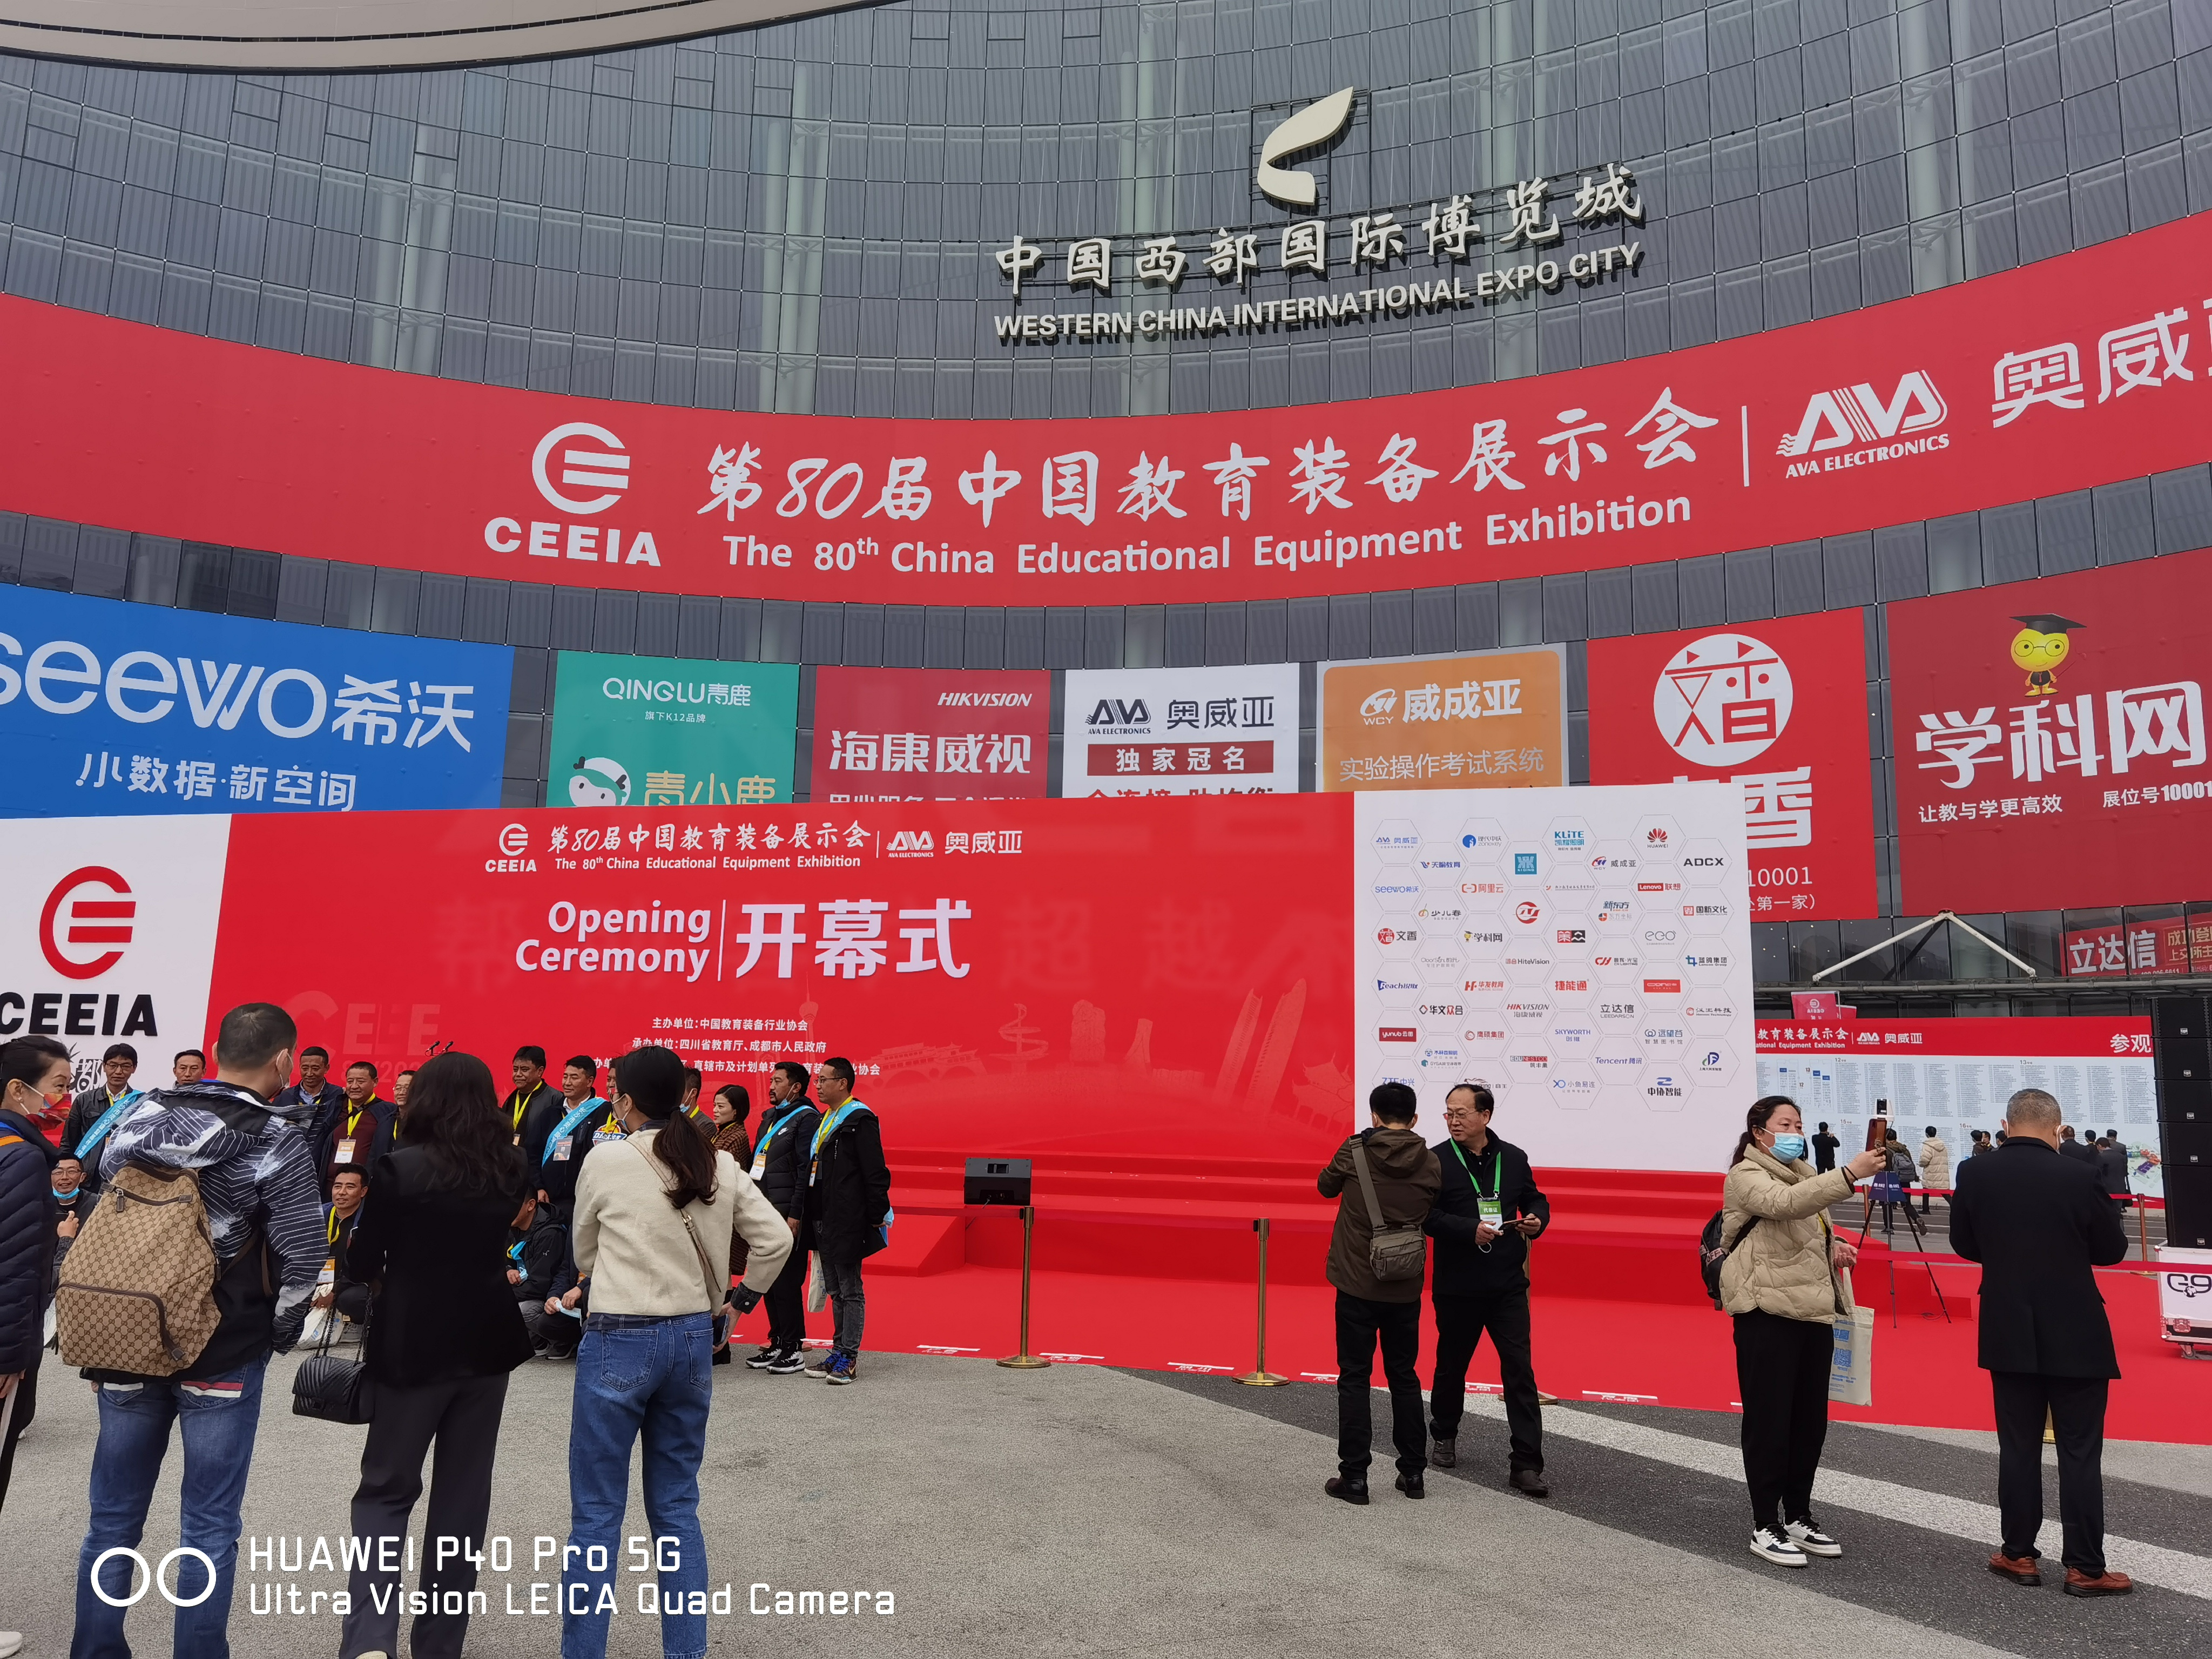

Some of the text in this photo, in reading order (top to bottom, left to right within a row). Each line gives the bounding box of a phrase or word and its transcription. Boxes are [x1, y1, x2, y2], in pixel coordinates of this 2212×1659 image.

[995, 163, 1643, 296] 中国西部国际博览城
[995, 241, 1641, 339] WESTERN CHINA INTERNATIONAL EXPO CITY
[1992, 298, 2212, 428] 奥威
[697, 387, 1718, 528] 第80届中国教育装备展示会
[1785, 434, 1949, 478] AVA ELECTRONICS
[484, 517, 661, 567] CEEIA
[723, 495, 1691, 574] The 80th China Educational Equipment Exhibition
[603, 677, 705, 705] QINGLU
[707, 683, 751, 707] 青鹿
[938, 692, 1033, 707] HIKVISION
[1402, 678, 1522, 723] 威成亚
[332, 674, 474, 752] 希沃
[645, 710, 706, 724] 旗下K12品牌
[1167, 696, 1274, 730] 奥威亚
[1363, 716, 1394, 725] WCY
[1916, 681, 2208, 790] 学科网
[830, 730, 1031, 773] 海康威视
[1116, 746, 1245, 773] 独家冠名
[1340, 747, 1544, 782] 实验操作考试系统
[2102, 780, 2212, 809] 展位号10001
[1918, 794, 2063, 825] 让教与学更高效
[548, 819, 871, 854] 第80届中国教育装备展示会
[945, 830, 1022, 854] 奥威亚
[485, 860, 537, 872] CEEIA
[556, 854, 860, 871] The 80th China Educational Equipment Exhibition
[1683, 858, 1725, 866] ADCX
[1478, 884, 1504, 893] 阿里云
[1603, 901, 1630, 911] 新东方
[548, 900, 711, 944] Opening
[1396, 930, 1417, 941] 文香
[735, 898, 972, 979] 开幕式
[1473, 933, 1503, 942] 学科网
[2168, 926, 2212, 947] 成功登
[516, 940, 710, 982] Ceremony
[2069, 930, 2156, 974] 立达信
[1555, 980, 1587, 991] 捷能通
[0, 992, 158, 1036] CEEIA
[1429, 1005, 1463, 1015] 华文众合
[1600, 1004, 1634, 1013] 立达信
[652, 1017, 808, 1032] 主办单位:中国教育装备行业协会
[1658, 1029, 1683, 1037] 远望谷
[1757, 1027, 1849, 1041] 教育装备展示会
[1885, 1033, 1923, 1044] 奥威亚
[2110, 1034, 2152, 1053] 参观
[1648, 1087, 1682, 1096] 中协智能
